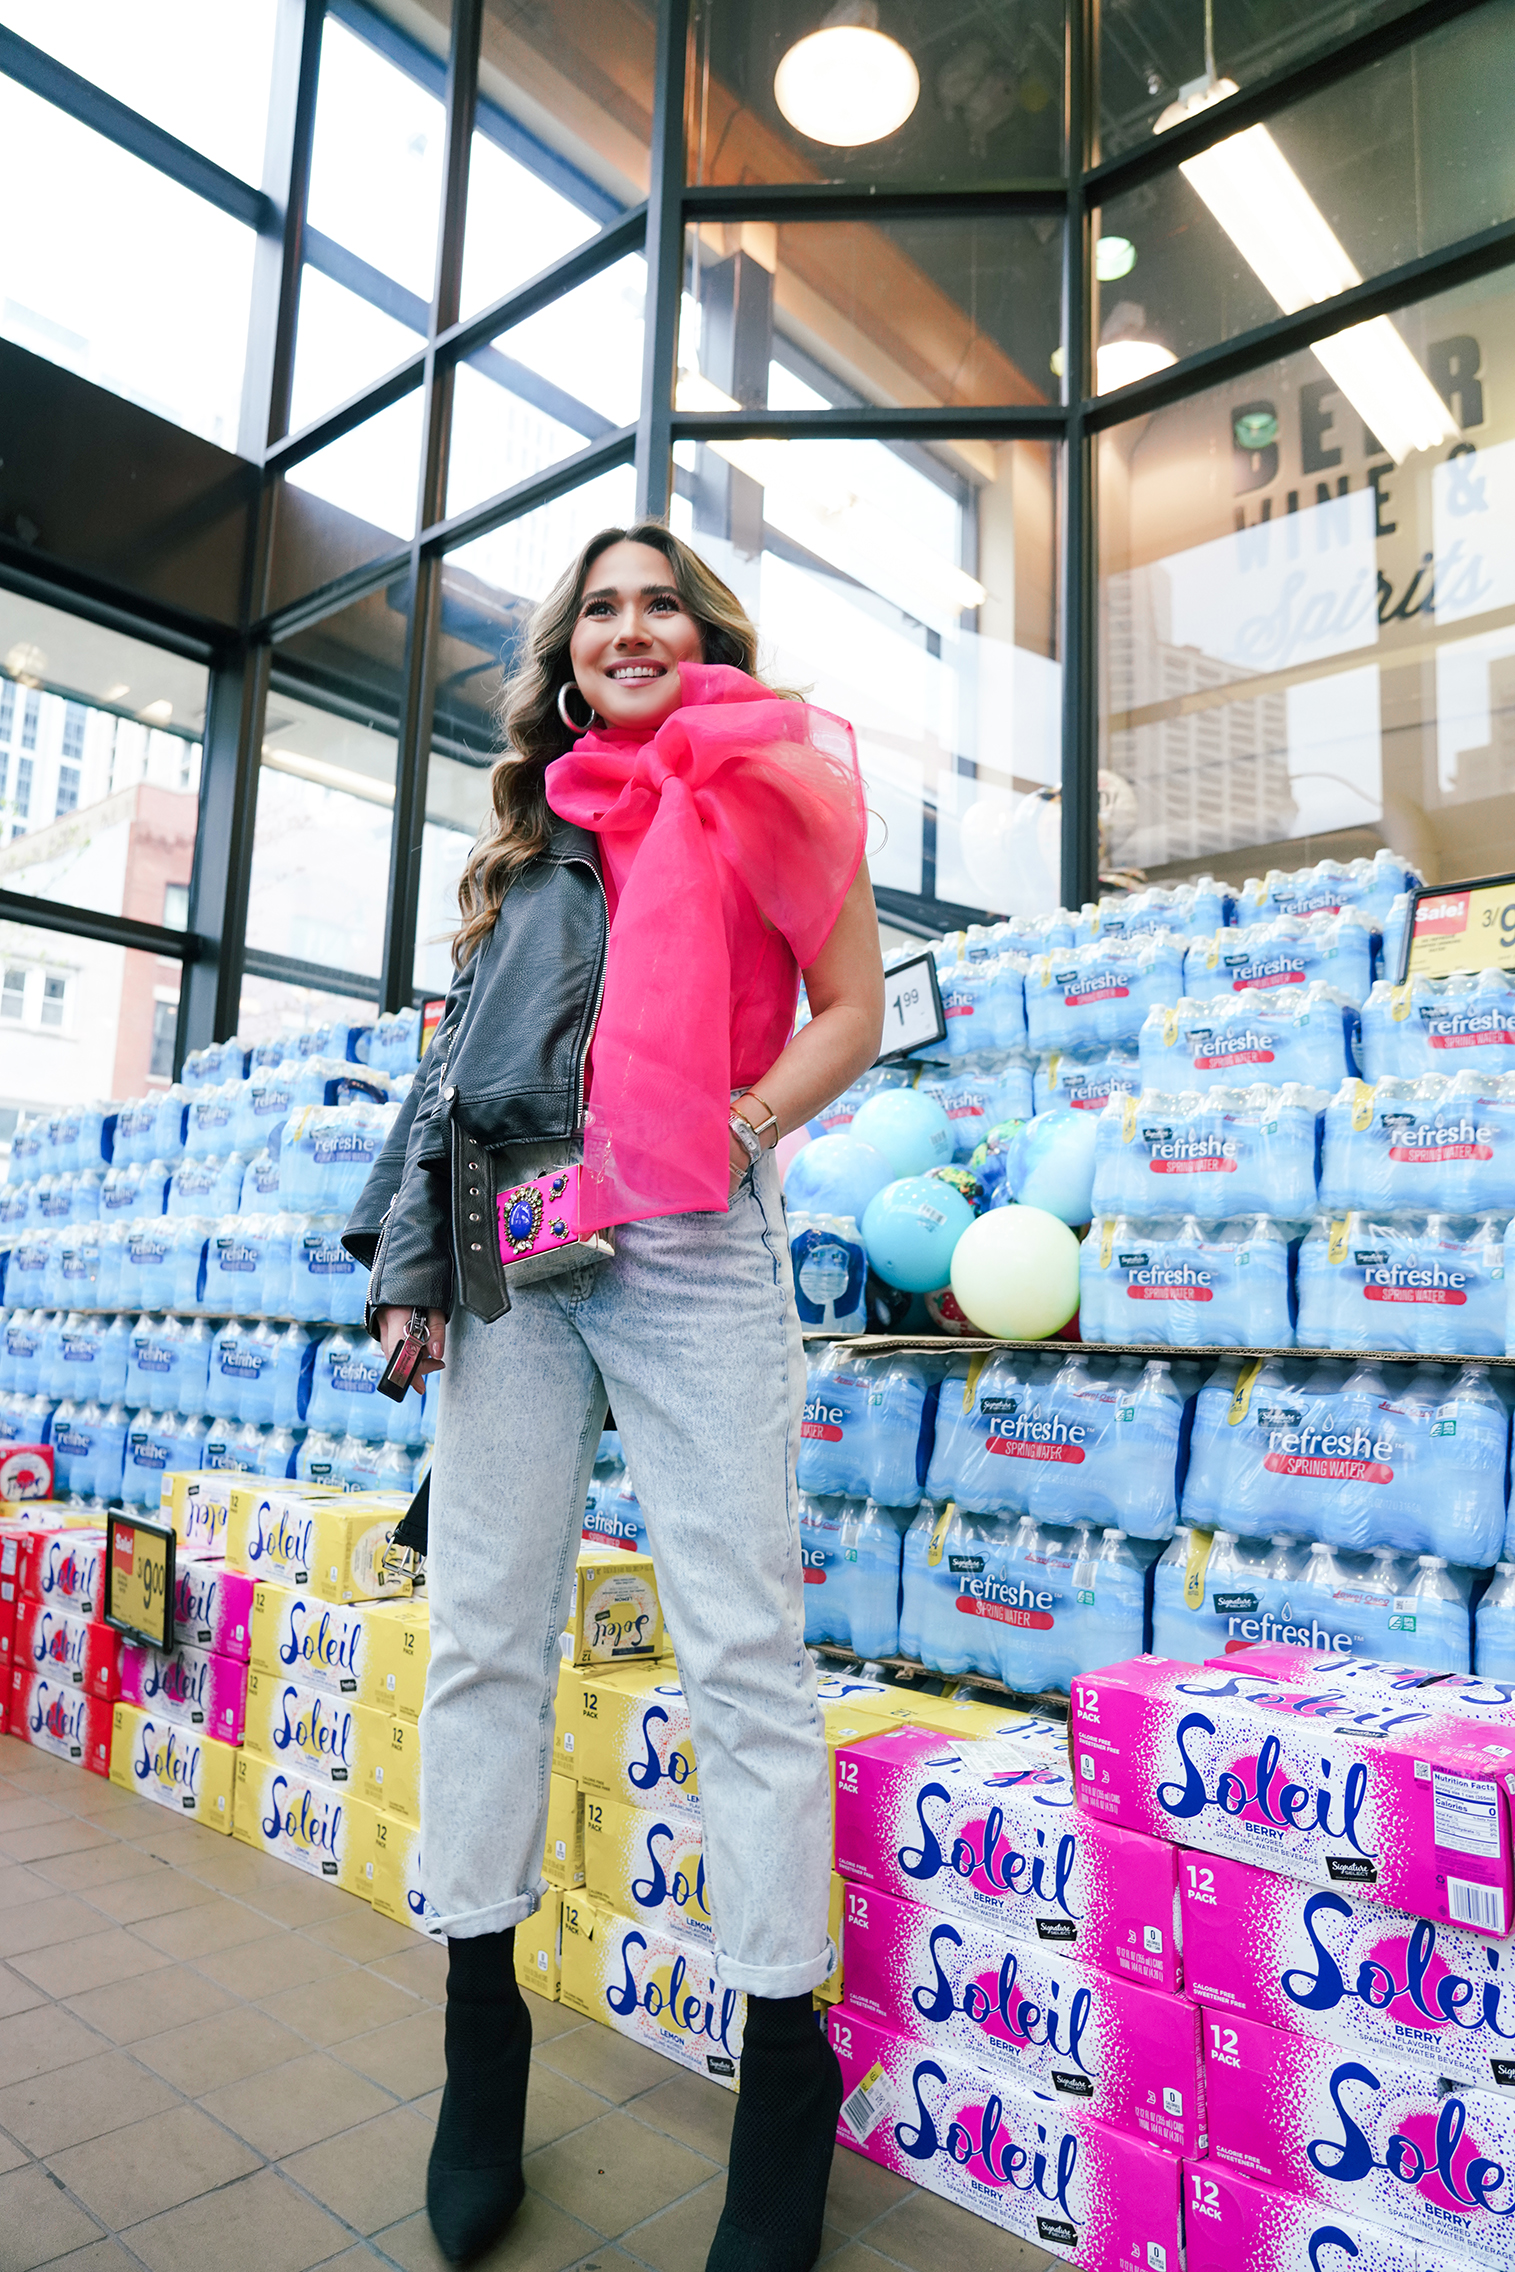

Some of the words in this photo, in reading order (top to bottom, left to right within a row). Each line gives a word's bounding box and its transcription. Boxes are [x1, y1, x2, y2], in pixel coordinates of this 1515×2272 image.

[1230, 335, 1486, 497] BER
[1235, 463, 1397, 574] WINE
[1445, 442, 1490, 517] &
[1228, 539, 1493, 669] Spirits
[1280, 890, 1347, 916] refreshe
[1415, 901, 1465, 922] Sale!
[1233, 954, 1305, 980] refreshe
[1064, 971, 1128, 996] refreshe
[1194, 1030, 1273, 1057] refreshe
[1445, 1035, 1475, 1047] SPRING
[1477, 1032, 1504, 1044] WATER
[1391, 1119, 1492, 1146] refreshe
[1151, 1135, 1236, 1158] refreshe
[1408, 1148, 1441, 1162] SPRING
[1443, 1146, 1472, 1159] WATER
[1129, 1263, 1212, 1285] refreshe
[1365, 1263, 1466, 1288] refreshe
[1382, 1288, 1414, 1301] SPRING
[1415, 1289, 1446, 1302] WATER
[989, 1413, 1086, 1443] refreshe
[1005, 1441, 1035, 1457] SPRING
[1036, 1444, 1062, 1460] WATER
[1269, 1427, 1393, 1461] refreshe
[1287, 1459, 1327, 1477] SPRING
[1329, 1461, 1366, 1479] WATER
[249, 1501, 313, 1570] Soleil
[42, 1541, 97, 1600] Soleil
[256, 1593, 266, 1607] 12
[959, 1573, 1053, 1609] refreshe
[975, 1601, 1003, 1620] SPRING
[1004, 1609, 1031, 1627] WATER
[279, 1601, 361, 1678] Soleil
[404, 1632, 415, 1648] 12
[593, 1614, 649, 1647] Soleil
[1228, 1612, 1353, 1654] refreshe
[33, 1611, 87, 1672] Soleil
[249, 1675, 259, 1689] 12
[583, 1692, 598, 1711] 12
[1076, 1687, 1099, 1712] 12
[30, 1680, 85, 1747] Soleil
[583, 1709, 599, 1720] PACK
[1077, 1709, 1101, 1724] PACK
[273, 1686, 352, 1768] Soleil
[392, 1727, 404, 1744] 12
[1078, 1731, 1098, 1744] CALORIE
[1098, 1737, 1111, 1747] FREE
[134, 1721, 200, 1797] Soleil
[1106, 1745, 1120, 1755] FREE
[238, 1760, 247, 1776] 12
[839, 1760, 859, 1784] 12
[838, 1781, 859, 1795] PACK
[1157, 1712, 1379, 1858] Soleil
[1434, 1773, 1469, 1788] Nutrition
[1471, 1782, 1495, 1792] Facts
[588, 1804, 603, 1824] 12
[1435, 1798, 1468, 1812] Calories
[1488, 1807, 1497, 1817] 0
[262, 1775, 342, 1862] Soleil
[588, 1822, 603, 1833] PACK
[376, 1823, 388, 1841] 12
[1245, 1822, 1285, 1841] BERRY
[1247, 1831, 1284, 1848] FLAVORED
[897, 1781, 1084, 1920] Soleil
[1215, 1830, 1254, 1847] SPARKLING
[1255, 1841, 1279, 1855] WATER
[1280, 1849, 1319, 1866] BEVERAGE
[838, 1857, 855, 1868] CALORIE
[856, 1863, 867, 1872] FREE
[1331, 1860, 1370, 1875] Signature
[863, 1871, 874, 1880] FREE
[1186, 1864, 1215, 1893] 12
[848, 1894, 868, 1919] 12
[973, 1891, 1005, 1909] BERRY
[974, 1899, 1004, 1915] FLAVORED
[1187, 1888, 1218, 1906] PACK
[566, 1905, 579, 1926] 12
[686, 1917, 713, 1933] LEMON
[848, 1914, 870, 1930] PACK
[951, 1898, 979, 1914] SPARKLING
[980, 1908, 999, 1920] WATER
[1000, 1915, 1030, 1931] BEVERAGE
[565, 1922, 580, 1936] PACK
[1040, 1922, 1071, 1935] Signature
[1150, 1929, 1156, 1940] 0
[606, 1930, 741, 2060] Soleil
[849, 1992, 869, 2004] CALORIE
[869, 1999, 880, 2009] FREE
[911, 1923, 1100, 2077] Soleil
[1193, 1982, 1219, 1995] CALORIE
[1220, 1989, 1236, 2000] FREE
[1193, 1988, 1230, 2004] SWEETENER
[1230, 1998, 1247, 2009] FREE
[876, 2007, 887, 2018] FREE
[660, 2028, 685, 2046] LEMON
[833, 2022, 852, 2049] 12
[1210, 2024, 1239, 2055] 12
[1395, 2025, 1442, 2046] BERRY
[1397, 2037, 1442, 2054] FLAVORED
[833, 2043, 854, 2060] PACK
[964, 2042, 997, 2060] SPARKLING
[997, 2056, 1017, 2069] WATER
[989, 2036, 1021, 2057] BERRY
[991, 2046, 1021, 2064] FLAVORED
[1359, 2033, 1404, 2052] SPARKLING
[1406, 2046, 1436, 2060] WATER
[1437, 2055, 1482, 2075] BEVERAGE
[1211, 2049, 1241, 2069] PACK
[1056, 2075, 1086, 2088] Signature
[1169, 2091, 1176, 2103] 0
[894, 2059, 1087, 2225] Soleil
[1216, 2145, 1243, 2158] CALORIE
[1243, 2153, 1261, 2164] FREE
[1216, 2151, 1255, 2169] SWEETENER
[1255, 2163, 1272, 2175] FREE
[970, 2180, 1004, 2201] BERRY
[972, 2189, 1003, 2208] FLAVORED
[1191, 2174, 1220, 2208] 12
[946, 2184, 979, 2204] SPARKLING
[979, 2200, 998, 2213] WATER
[999, 2208, 1031, 2229] BEVERAGE
[1191, 2200, 1222, 2222] PACK
[1424, 2202, 1472, 2229] BERRY
[1041, 2221, 1071, 2235] Signature
[1388, 2207, 1434, 2230] SPARKLING
[1435, 2226, 1465, 2243] WATER
[1467, 2239, 1514, 2261] BEVERAGE
[1427, 2214, 1471, 2238] FLAVORED
